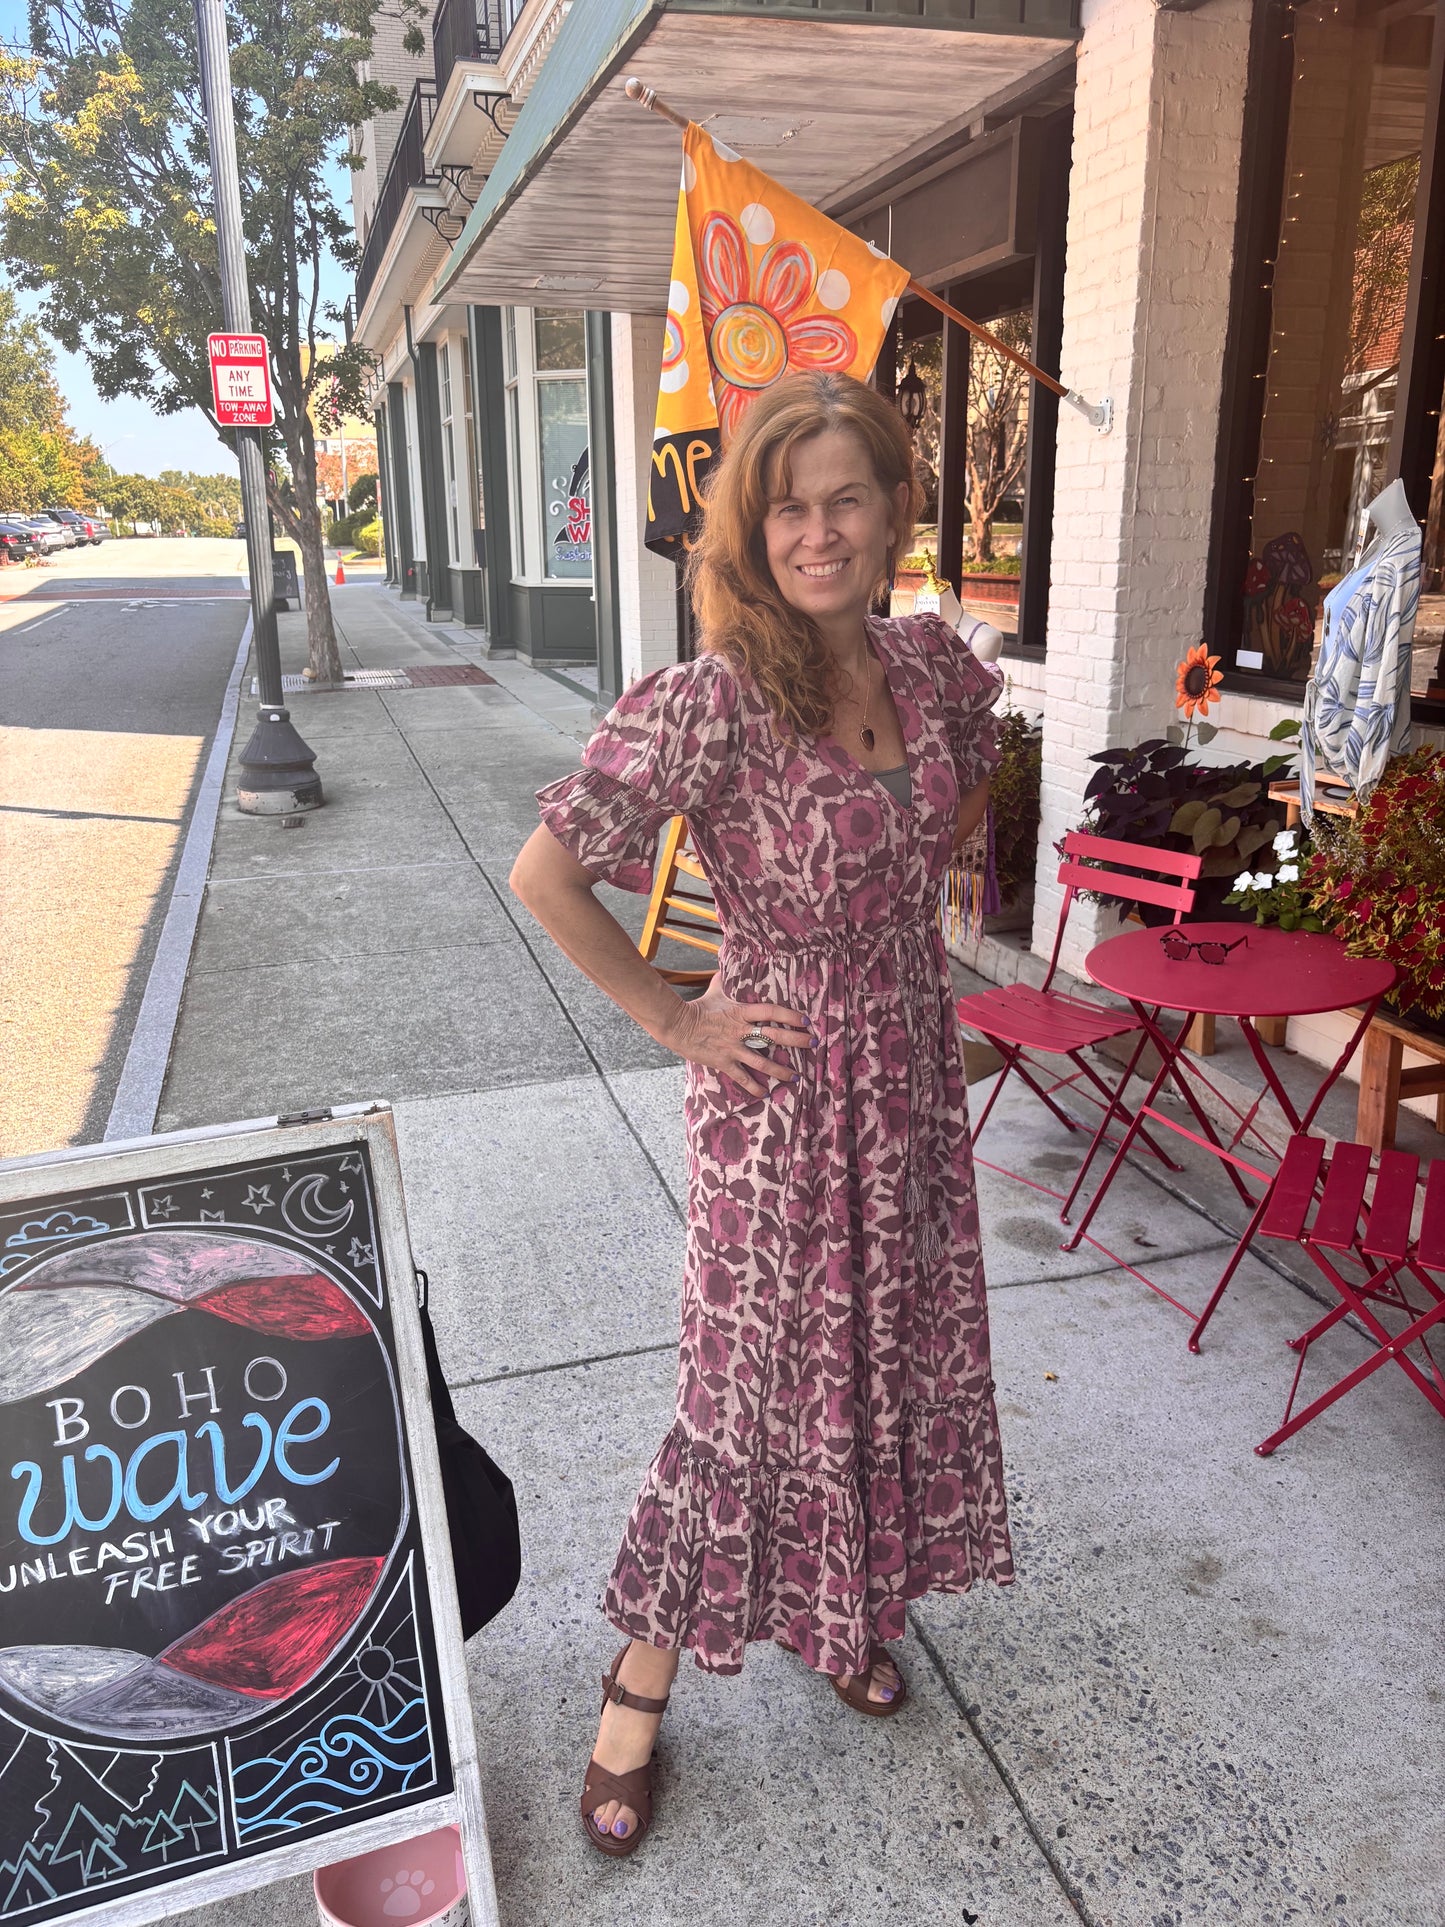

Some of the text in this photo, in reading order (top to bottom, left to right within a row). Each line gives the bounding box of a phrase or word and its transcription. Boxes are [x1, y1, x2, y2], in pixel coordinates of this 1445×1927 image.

[211, 340, 262, 357] NO PARKING
[228, 370, 250, 382] ANY
[228, 385, 254, 397] TIME
[220, 402, 267, 412] TOW-AWAY
[232, 413, 257, 422] ZONE
[45, 1356, 288, 1446] BOHO
[11, 1397, 341, 1546] wave
[0, 1498, 297, 1593] UNLEASH YOUR
[102, 1521, 342, 1605] FREE SPIRIT
